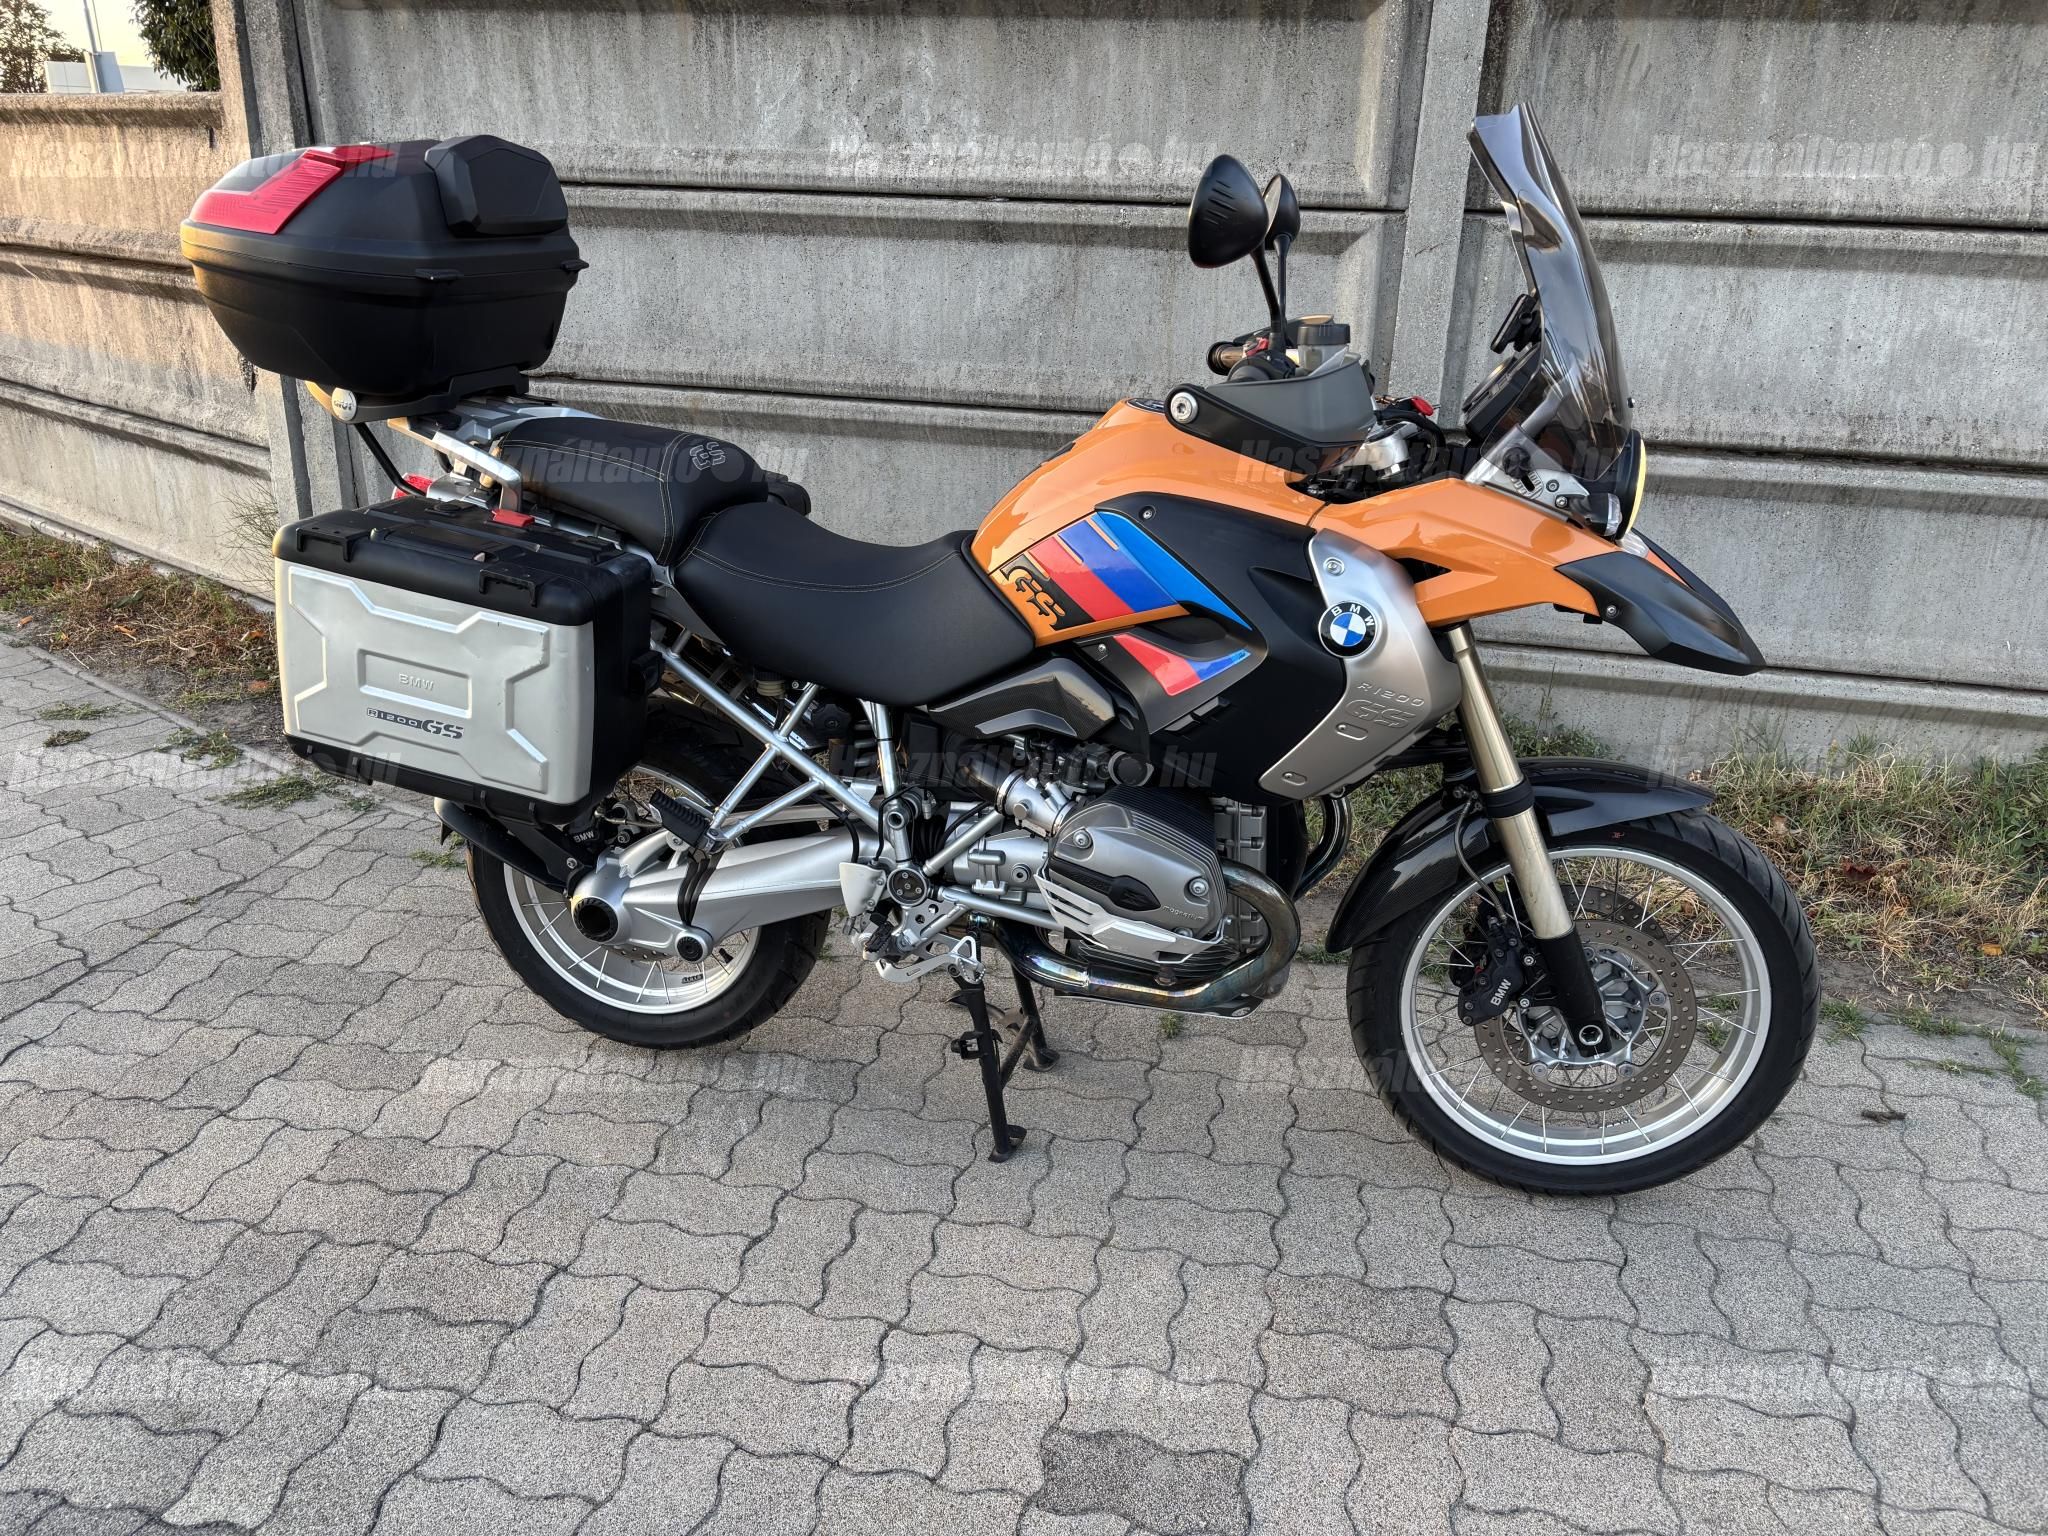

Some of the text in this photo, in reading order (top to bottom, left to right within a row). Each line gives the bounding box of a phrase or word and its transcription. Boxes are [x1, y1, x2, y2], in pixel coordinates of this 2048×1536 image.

[1331, 603, 1375, 627] BMW
[399, 673, 434, 691] BMW
[573, 830, 595, 843] BMW
[1490, 978, 1512, 1006] BMW
